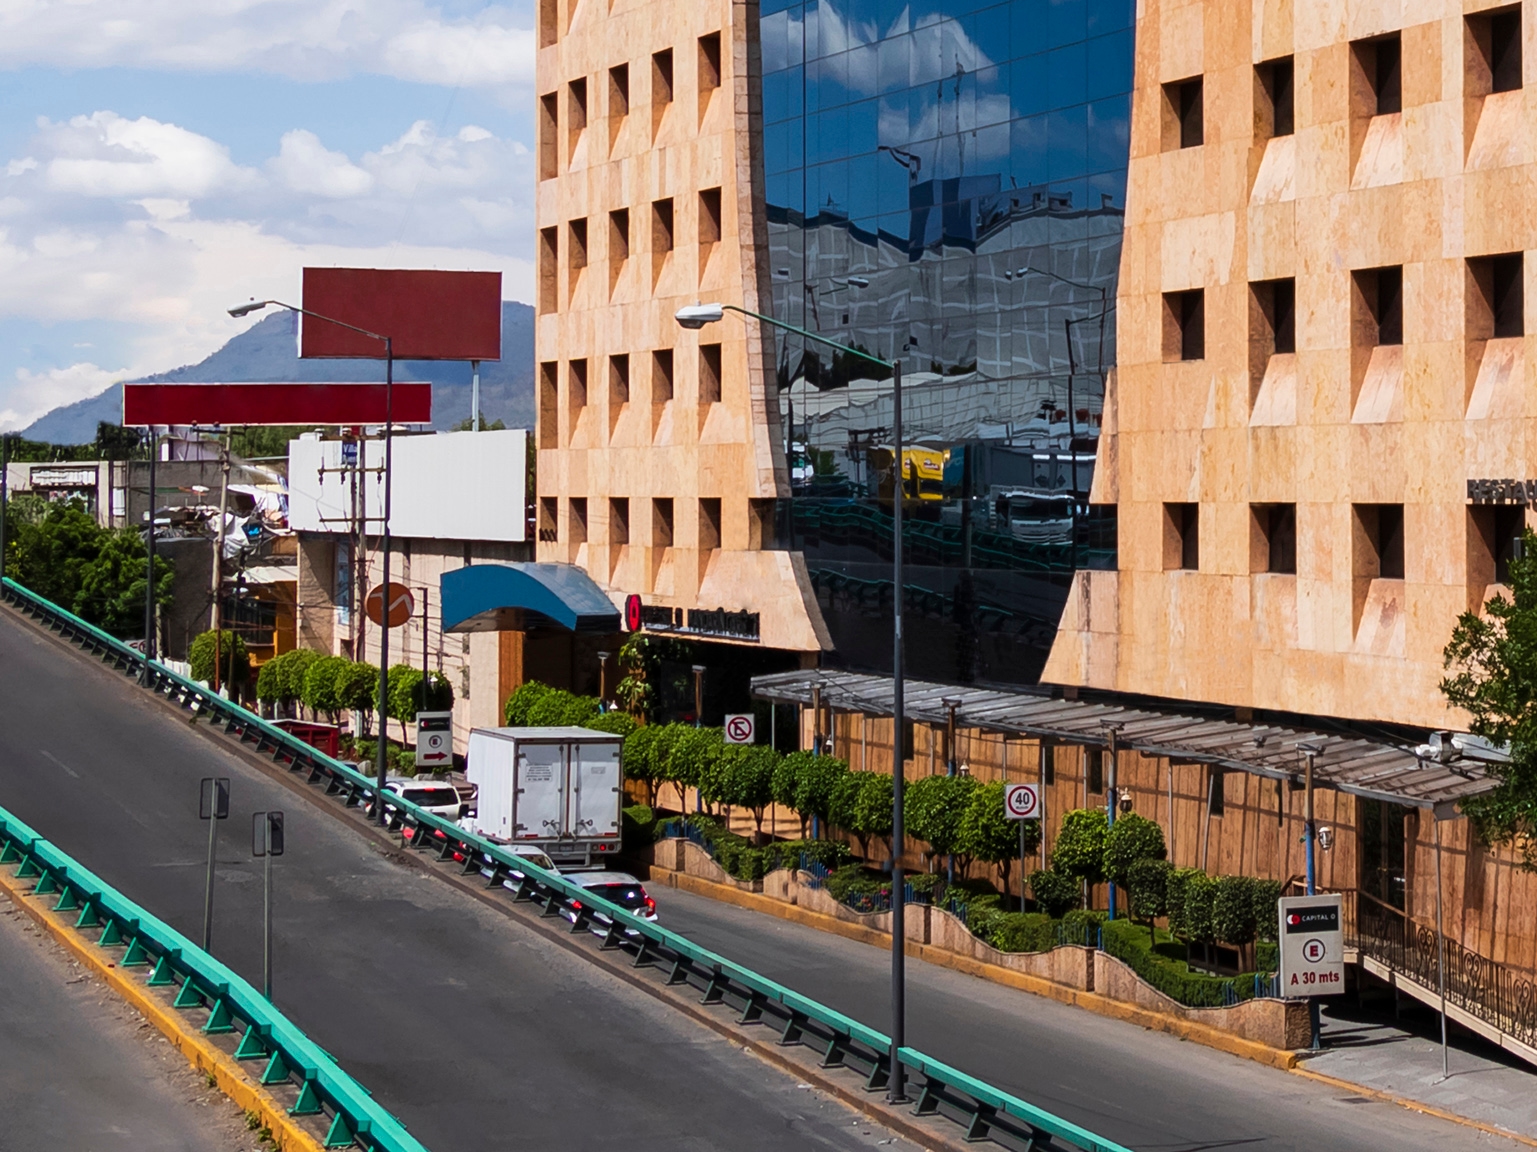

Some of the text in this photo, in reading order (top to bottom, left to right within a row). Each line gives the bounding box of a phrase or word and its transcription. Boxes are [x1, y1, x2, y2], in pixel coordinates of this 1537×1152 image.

[1015, 792, 1030, 805] 40
[1301, 913, 1329, 922] CAPITAL
[1310, 945, 1319, 957] E
[1291, 970, 1340, 986] A 30 mts
